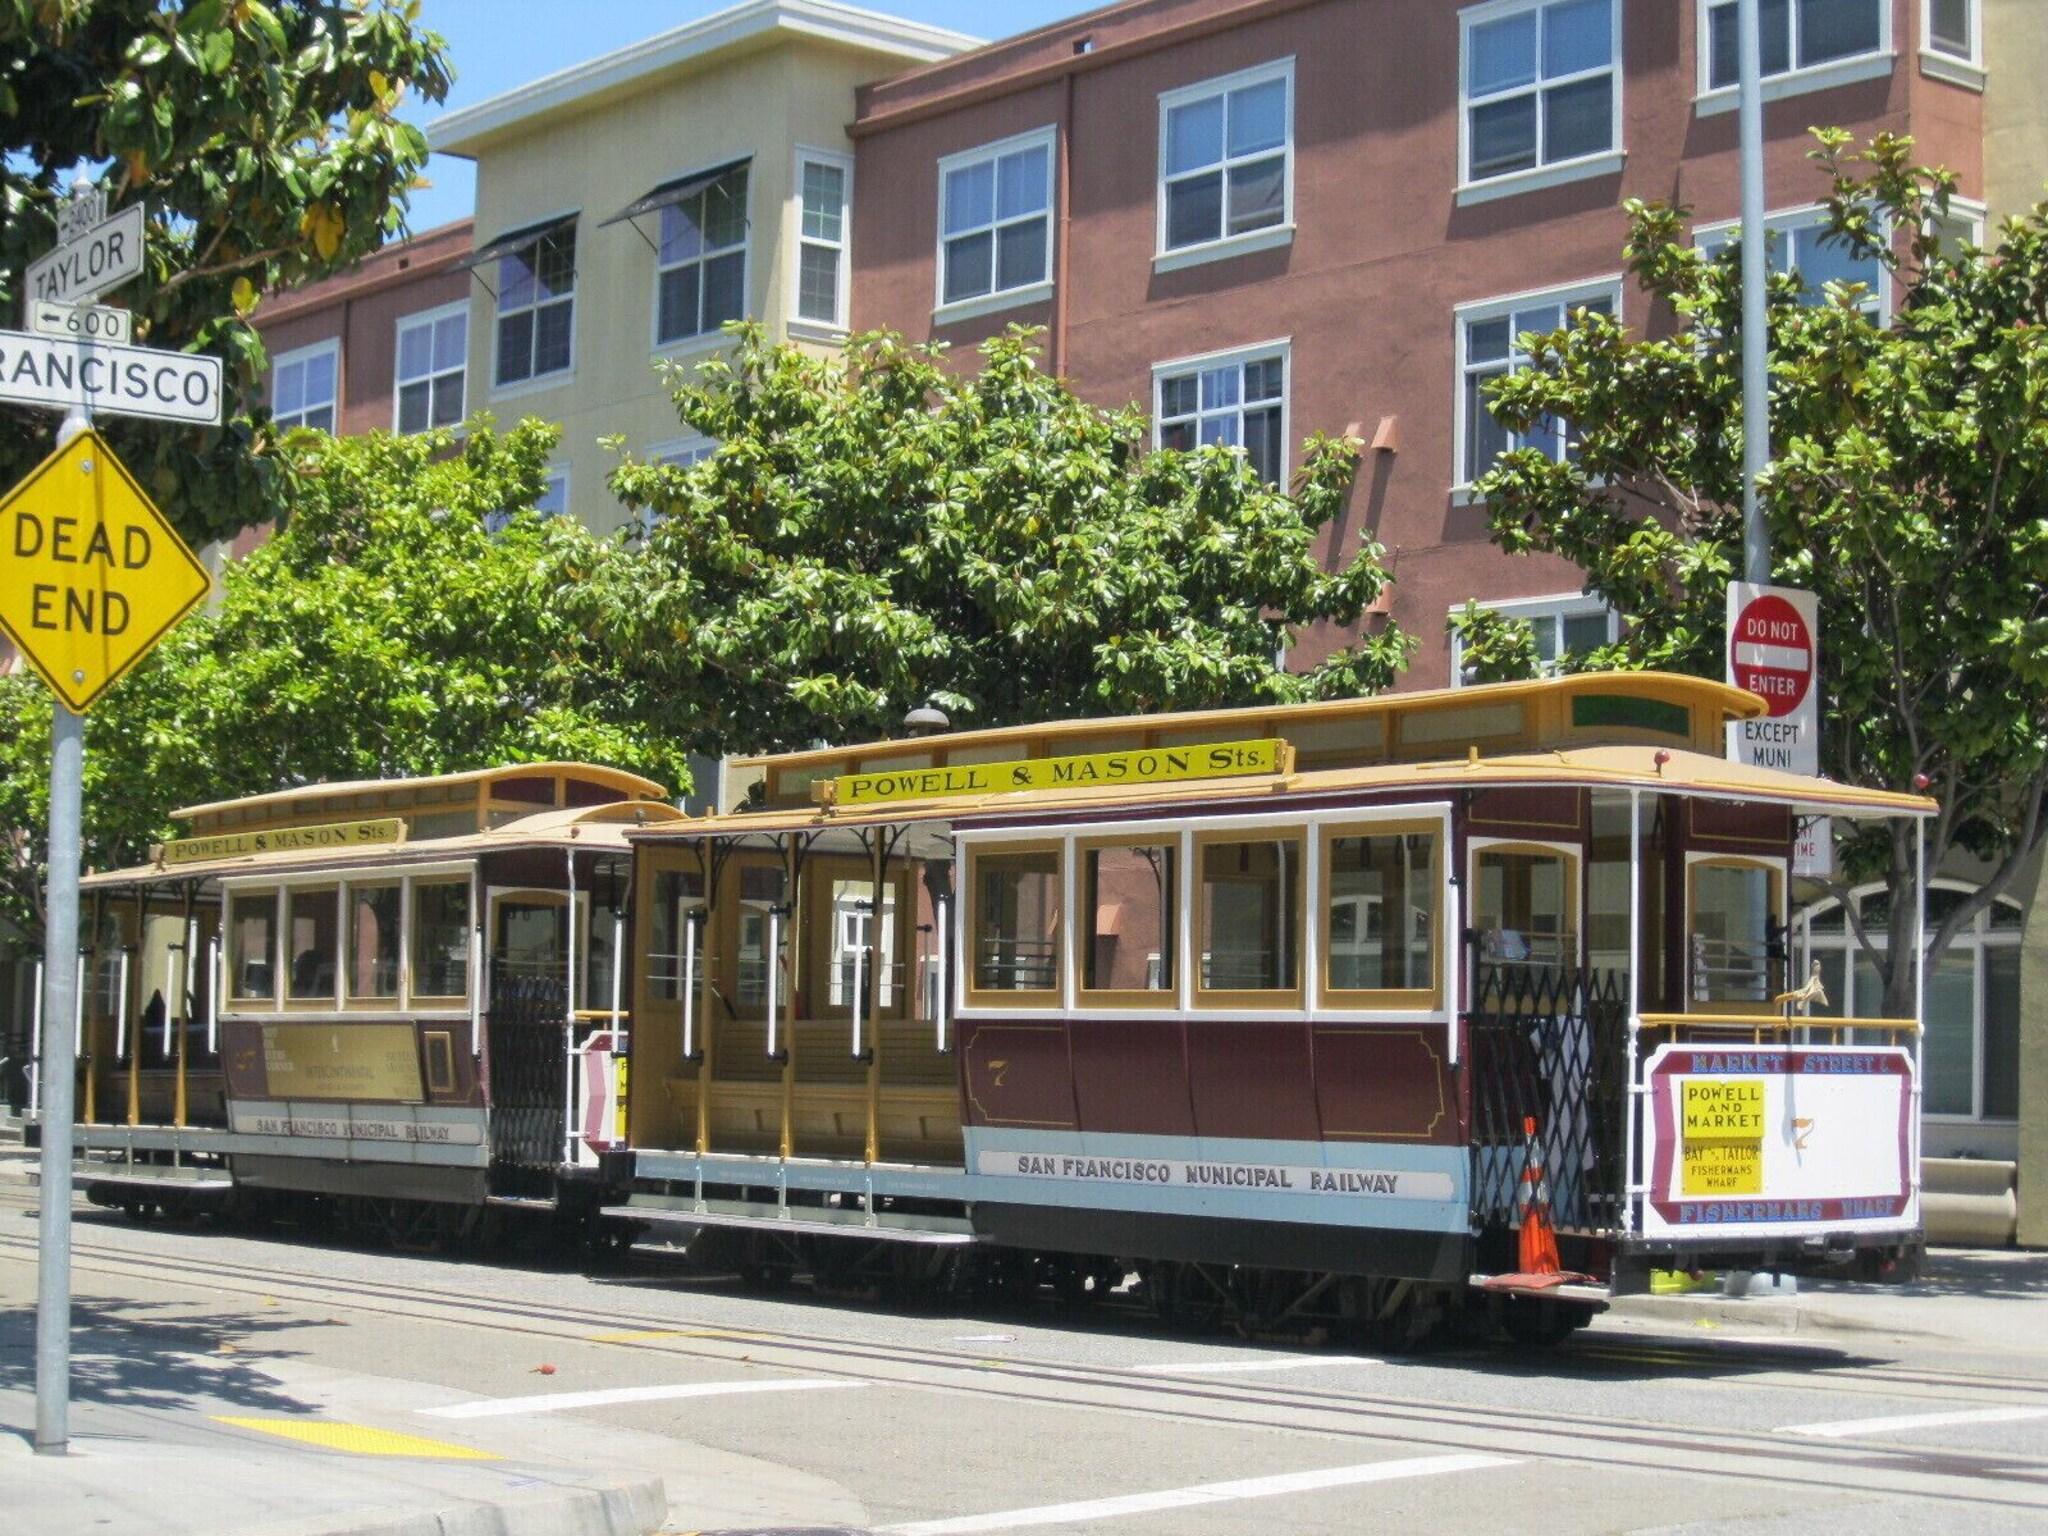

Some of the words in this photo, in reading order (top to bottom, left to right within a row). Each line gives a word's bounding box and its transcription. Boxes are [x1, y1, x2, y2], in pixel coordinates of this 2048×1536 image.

[36, 231, 124, 302] TAYLOR
[66, 311, 119, 337] 600
[0, 348, 209, 406] ANCISCO
[14, 512, 152, 570] DEAD
[32, 583, 130, 636] END
[1747, 618, 1766, 638] DO
[1770, 621, 1798, 641] NOT
[1749, 674, 1796, 696] ENTER
[1745, 721, 1799, 744] EXCEPT
[1753, 747, 1791, 768] MUNI
[851, 770, 988, 798] POWELL
[1012, 766, 1032, 786] &
[1052, 752, 1190, 783] MASON
[1209, 748, 1266, 770] Sts.
[175, 838, 248, 858] POWELL
[255, 834, 266, 850] &
[274, 828, 348, 849] MASON
[1796, 842, 1816, 857] IME
[988, 1060, 1008, 1087] 7
[1692, 1054, 1784, 1073] MARKET
[1803, 1054, 1875, 1073] STREET
[1689, 1087, 1760, 1101] POWELL
[1708, 1103, 1742, 1112] AND
[256, 1119, 278, 1133] SAN
[281, 1121, 337, 1136] FRANCISCO
[406, 1125, 450, 1140] RAILWAY
[1688, 1115, 1760, 1127] MARKET
[1684, 1146, 1703, 1161] BAY
[1722, 1145, 1759, 1161] TAYLOR
[1018, 1155, 1055, 1175] SAN
[1062, 1159, 1171, 1183] FRANCISCO
[1310, 1171, 1399, 1194] RAILWAY
[1691, 1165, 1752, 1176] FISHERMANS
[1706, 1177, 1737, 1188] WHARF
[1680, 1200, 1822, 1224] FISHERMANS
